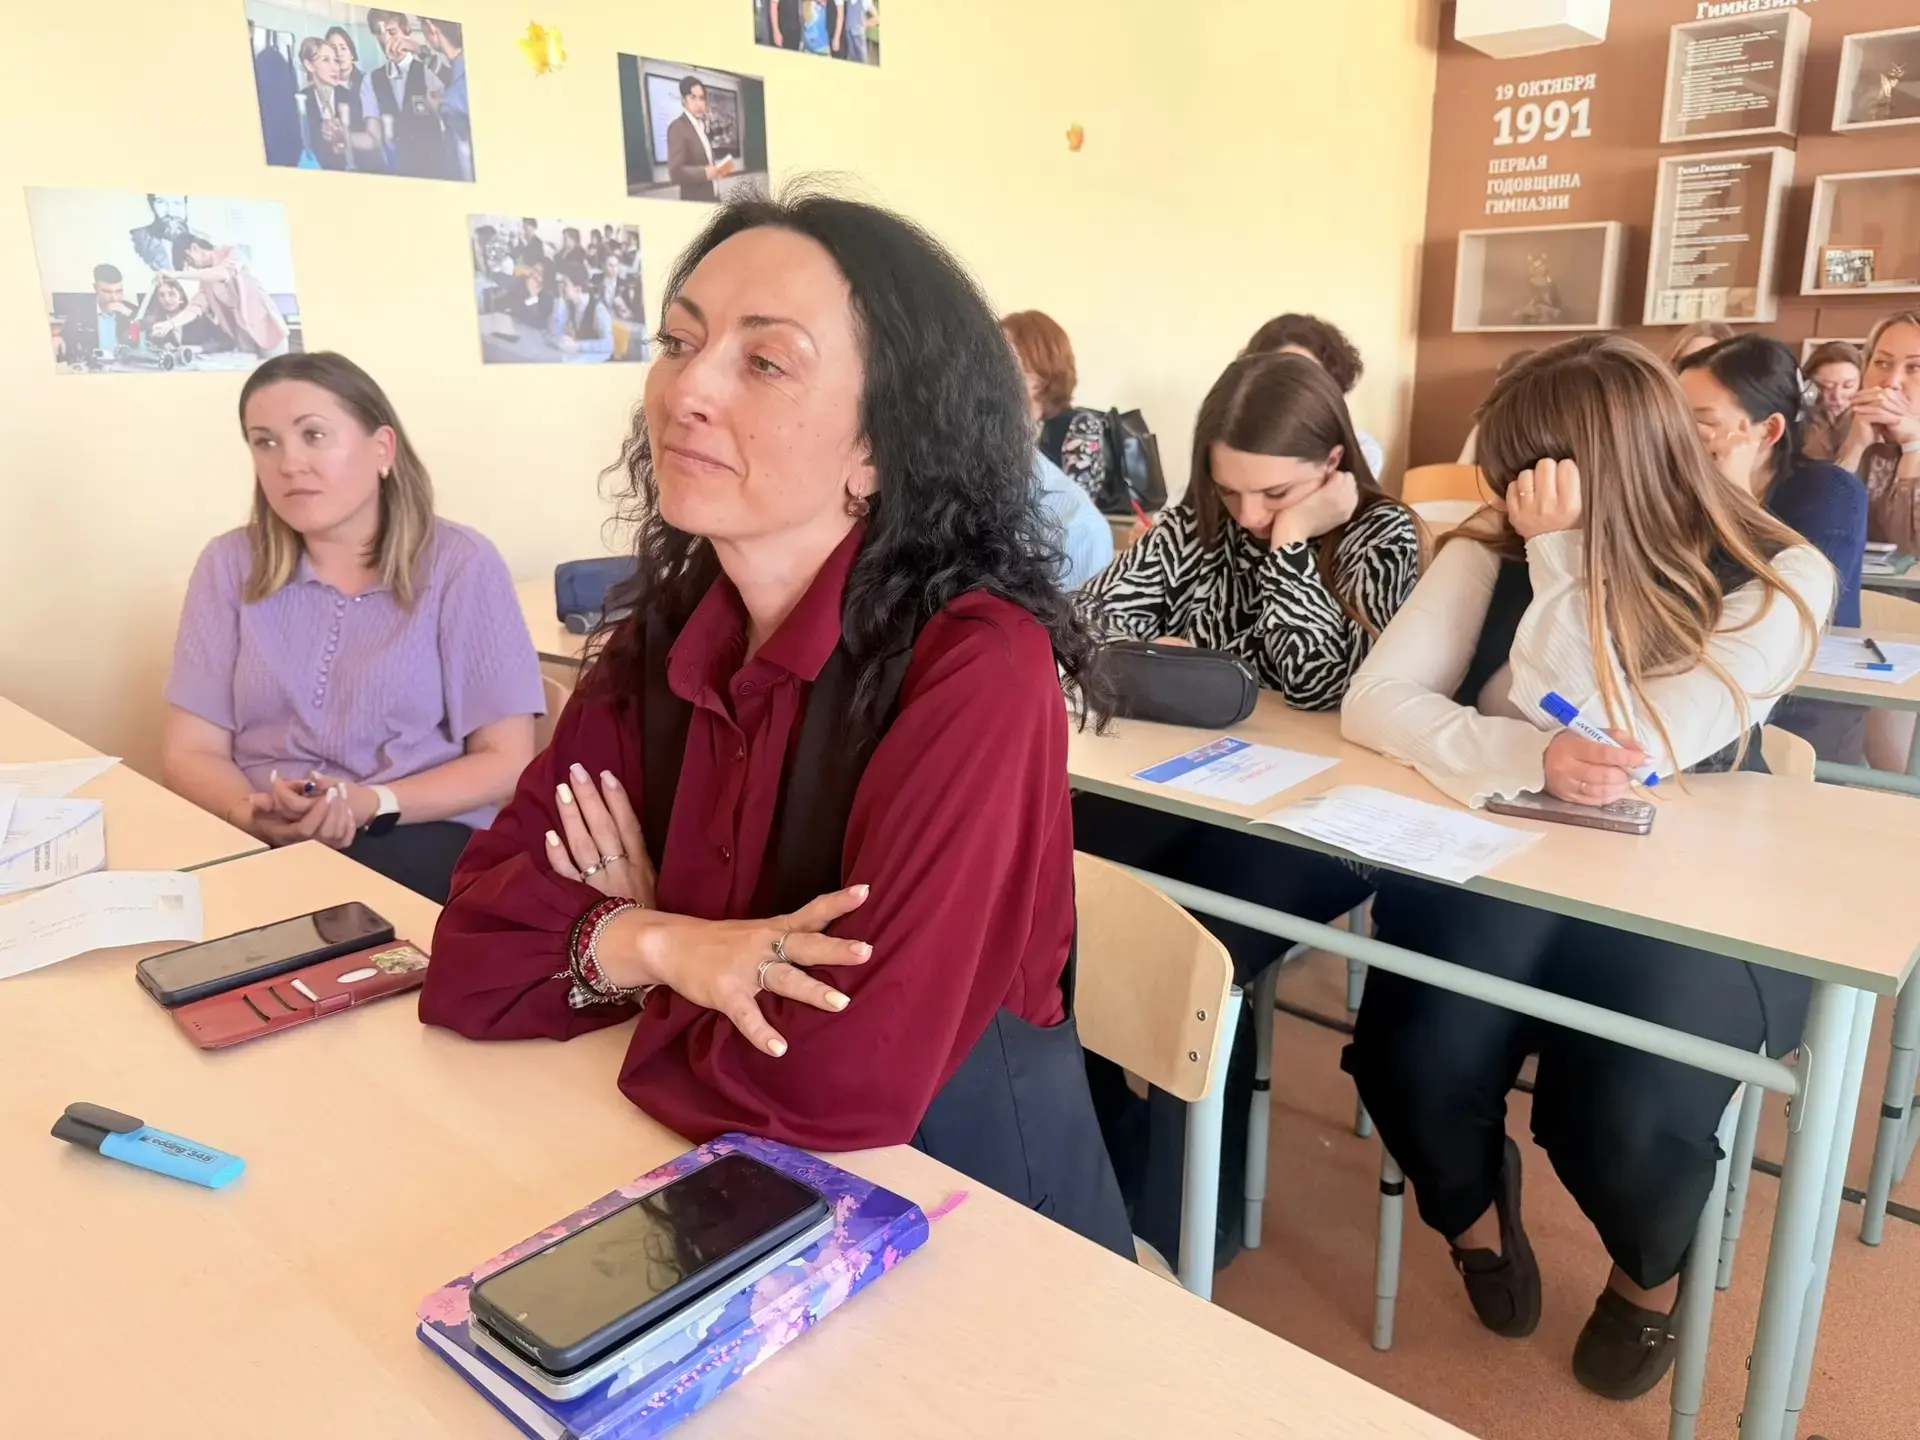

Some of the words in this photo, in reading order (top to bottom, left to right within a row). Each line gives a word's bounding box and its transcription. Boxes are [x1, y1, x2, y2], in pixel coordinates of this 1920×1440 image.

[1495, 83, 1514, 101] 19
[1517, 73, 1597, 98] ОКТЯБРЯ
[1493, 97, 1592, 146] 1991
[1488, 155, 1548, 174] ПЕРВАЯ
[1486, 173, 1581, 195] ГОДОВЩИНА
[1485, 194, 1570, 215] ГИМНАЗИИ
[151, 1138, 187, 1154] edding
[187, 1149, 214, 1162] 345
